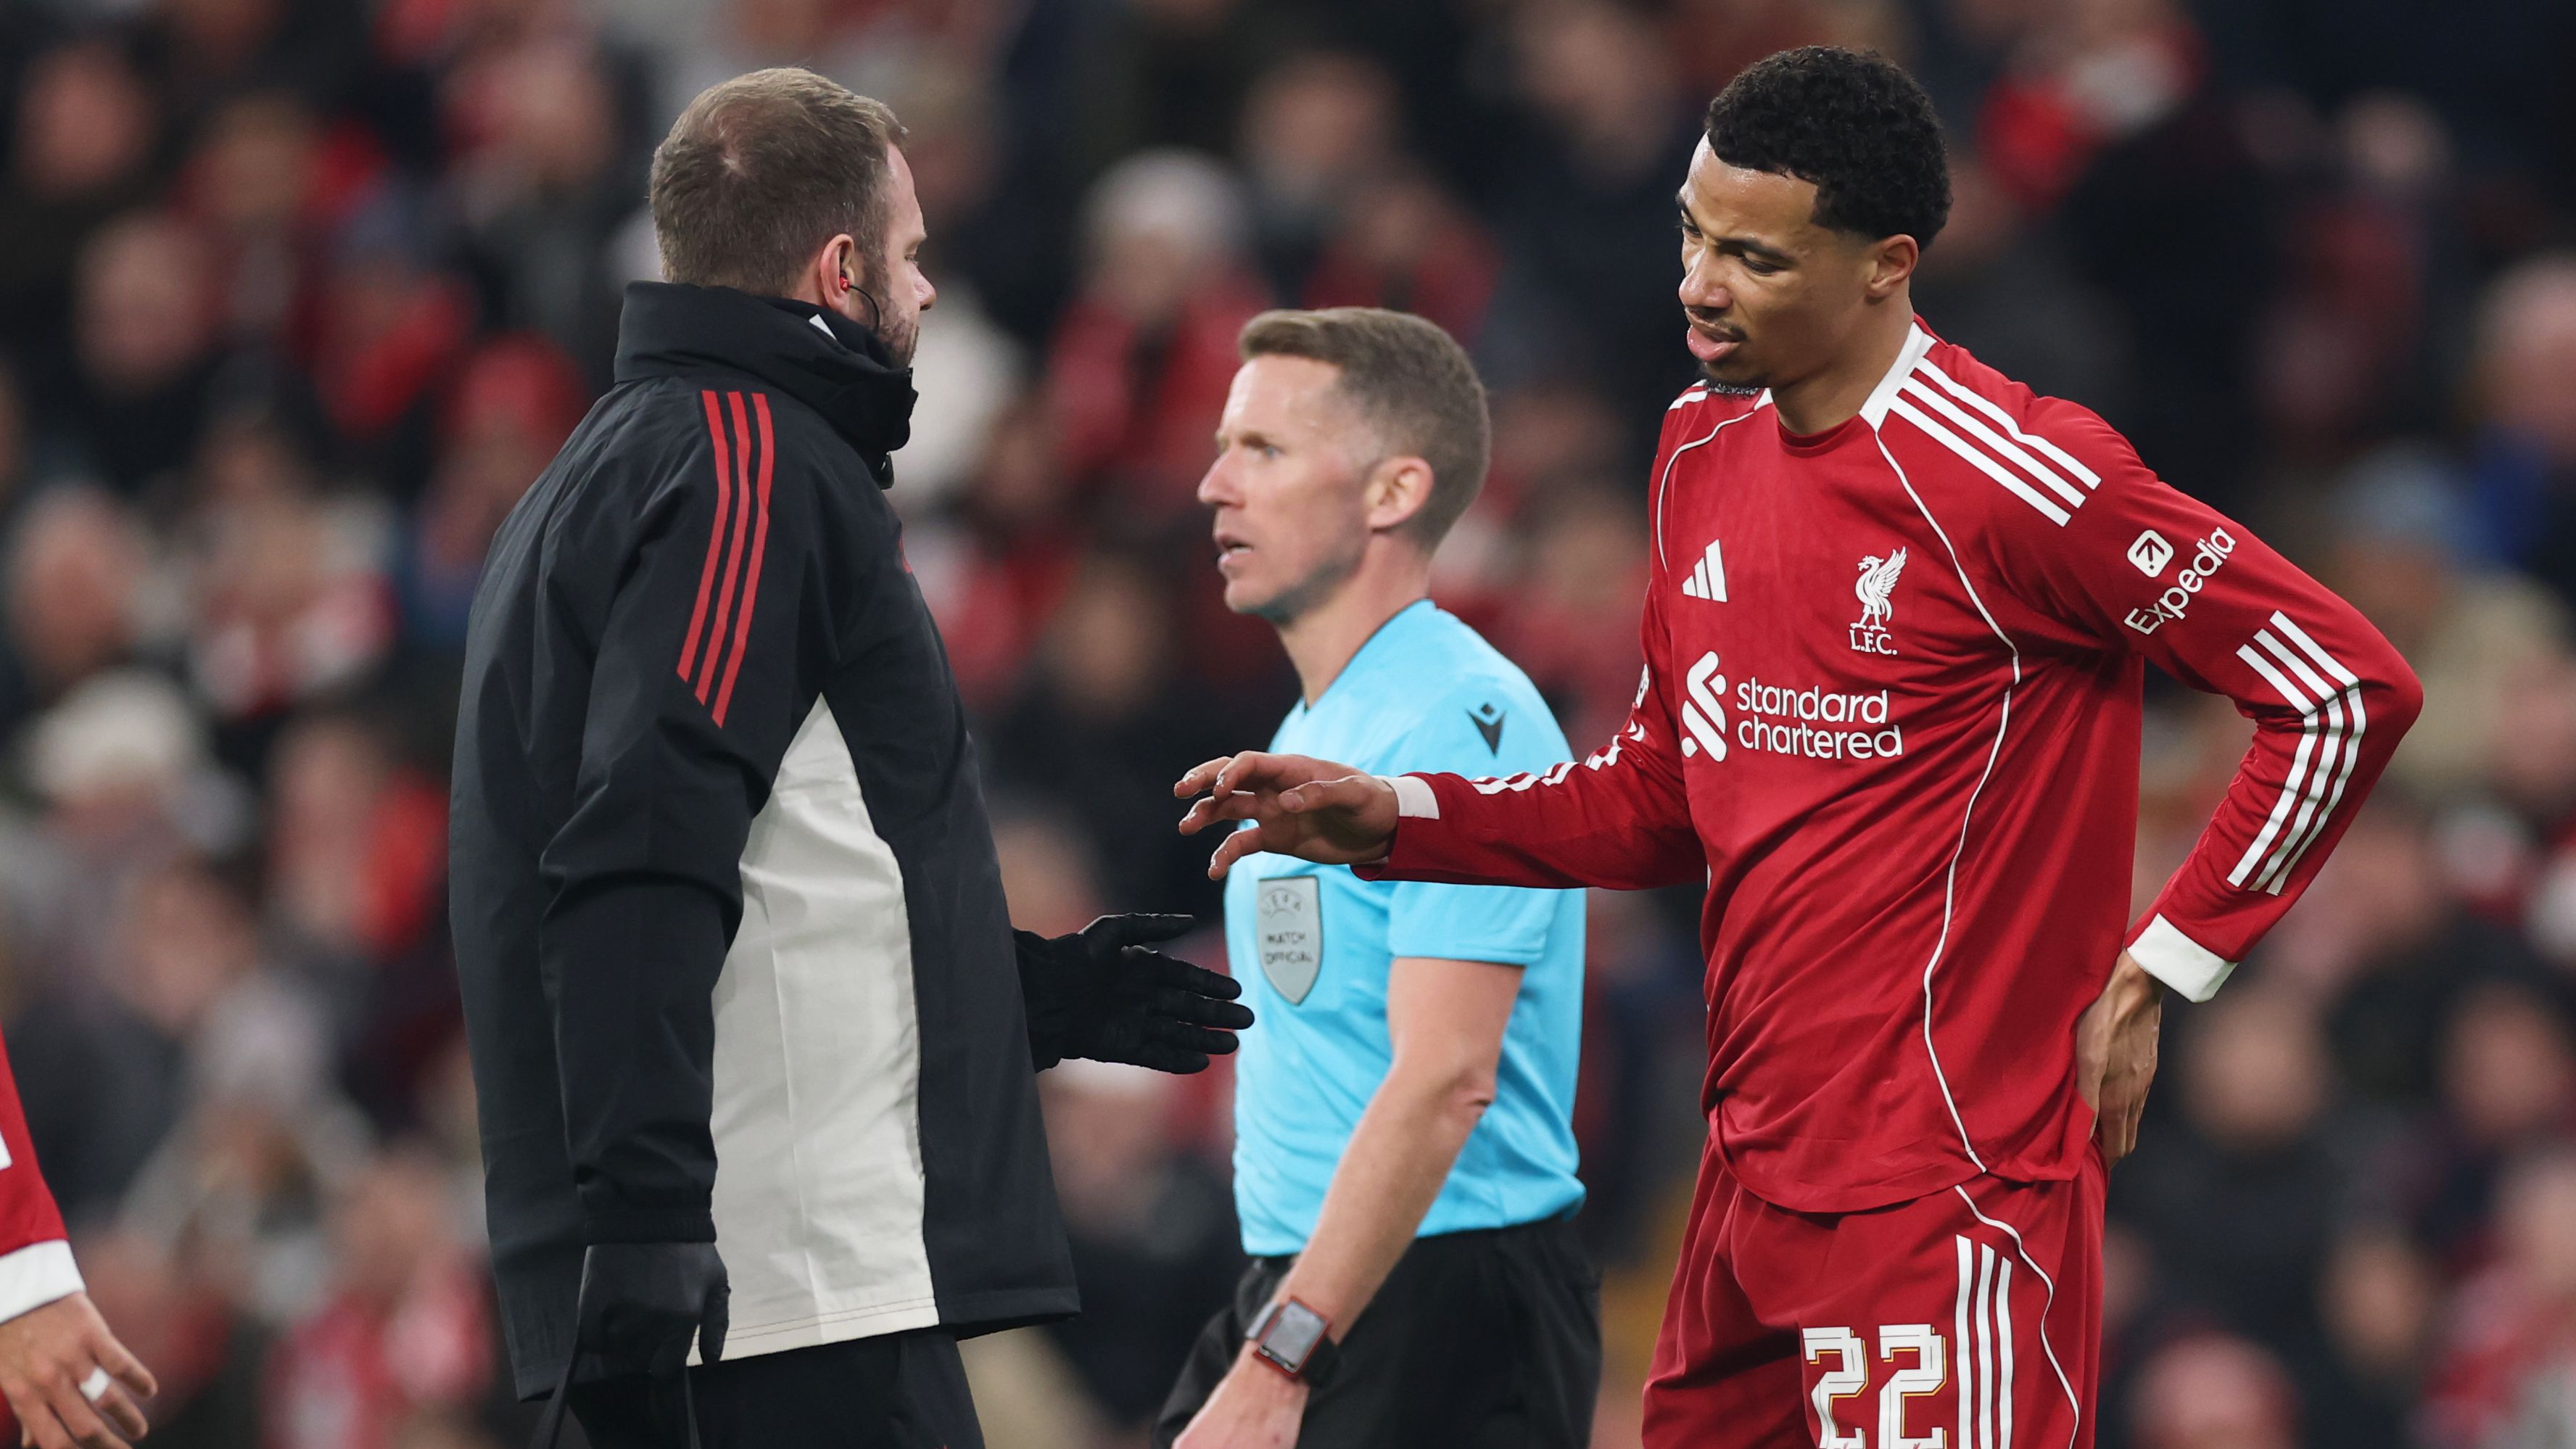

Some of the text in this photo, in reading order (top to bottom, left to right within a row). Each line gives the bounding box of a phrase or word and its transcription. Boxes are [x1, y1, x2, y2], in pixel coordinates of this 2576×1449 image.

[2123, 527, 2236, 635] Expedia
[1736, 677, 1888, 724] standard
[1737, 715, 1904, 759] chartered
[1802, 1324, 1947, 1449] 22
